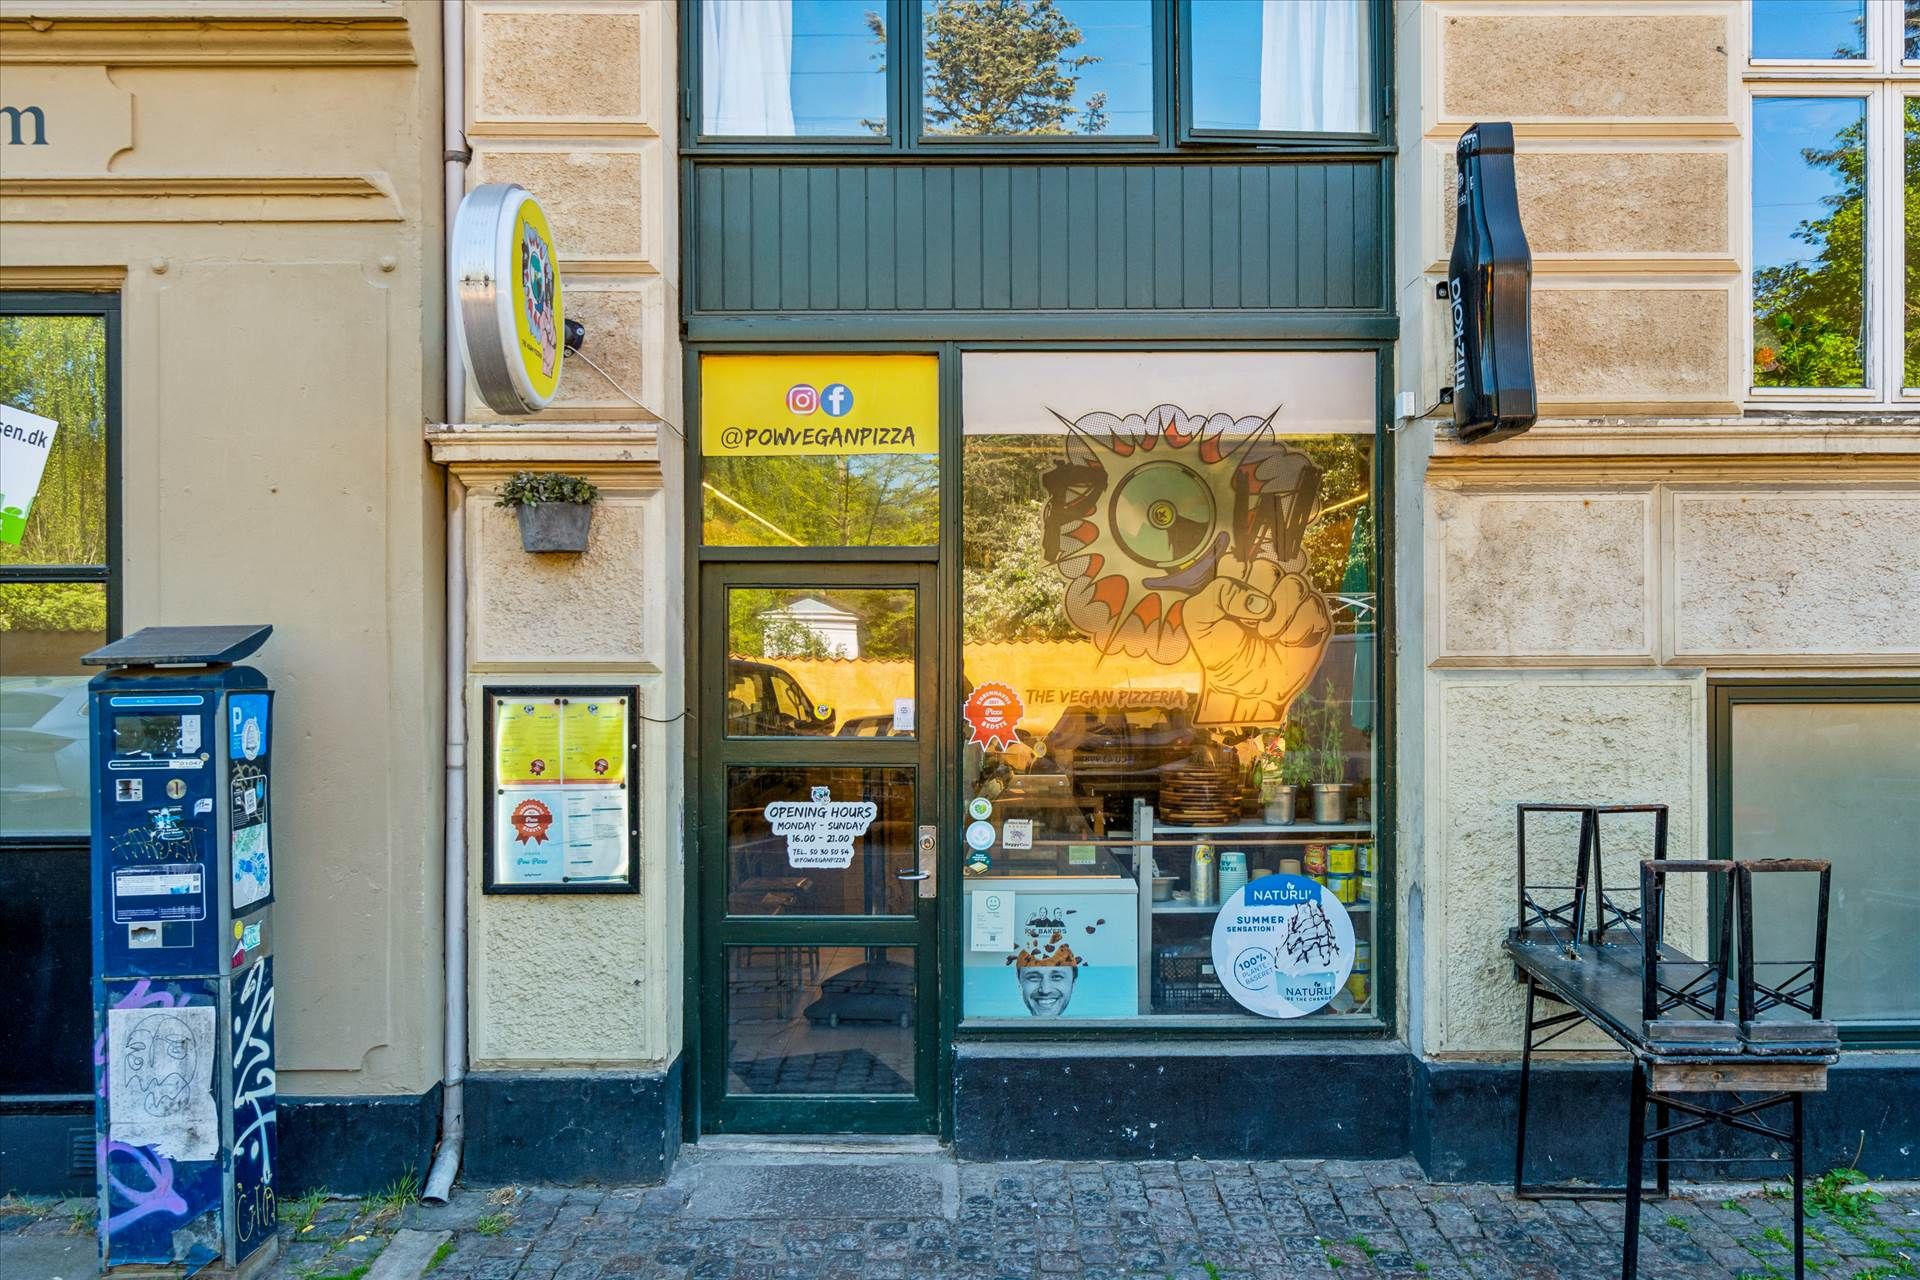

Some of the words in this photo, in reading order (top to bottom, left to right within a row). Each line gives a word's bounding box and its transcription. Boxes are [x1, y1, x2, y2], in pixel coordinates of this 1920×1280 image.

[721, 426, 916, 449] @POWVEGANPIZZA
[1026, 689, 1054, 705] THE
[1059, 689, 1114, 705] VEGAN
[1117, 689, 1185, 706] PIZZERIA
[232, 706, 242, 733] P
[769, 806, 828, 818] OPENING
[831, 806, 872, 819] HOURS
[777, 822, 817, 831] MONDAY
[827, 822, 865, 830] SUNDAY
[792, 834, 816, 843] 16.00
[826, 834, 850, 843] 21.00
[1254, 889, 1312, 901] NATURLI'
[1236, 915, 1285, 924] SUMMER
[1238, 953, 1267, 971] 100%
